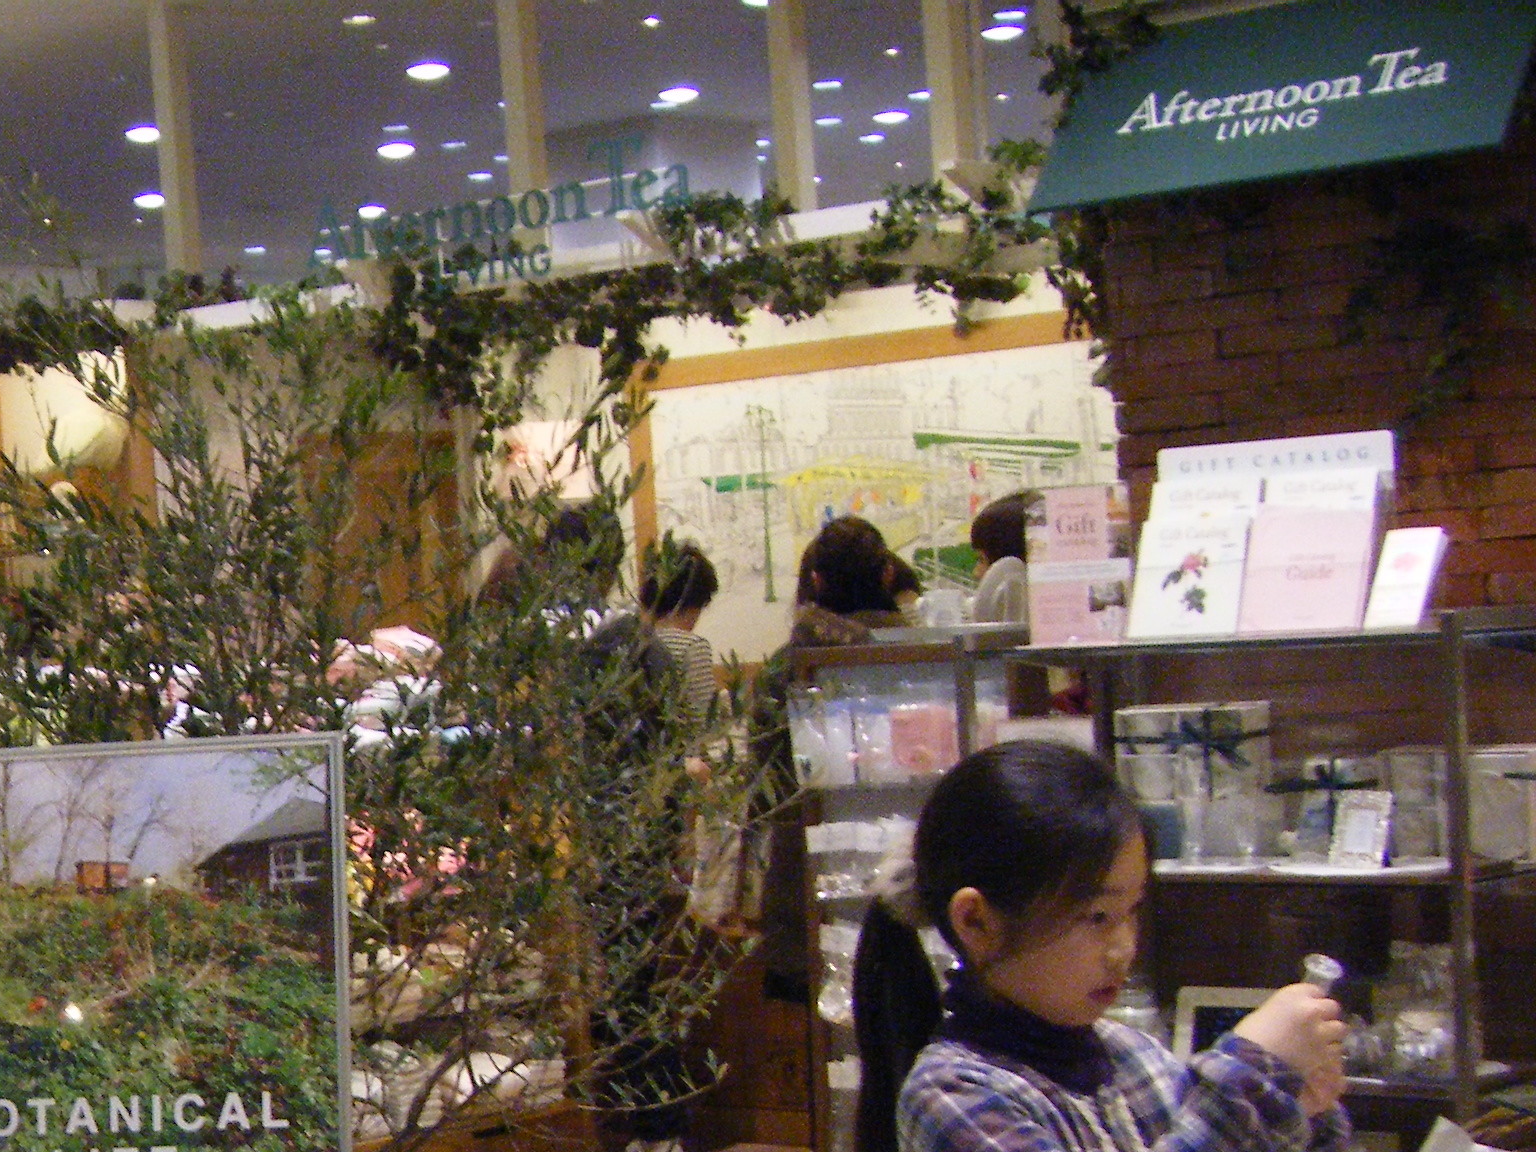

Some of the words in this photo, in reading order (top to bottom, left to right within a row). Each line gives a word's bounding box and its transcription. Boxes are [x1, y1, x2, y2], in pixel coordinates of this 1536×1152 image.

[1117, 75, 1362, 134] Afternoon
[1367, 47, 1449, 95] Tea
[1216, 108, 1320, 141] LIVING
[586, 136, 693, 218] Tea
[1179, 457, 1235, 474] GIFT
[1252, 446, 1369, 468] CATALOG
